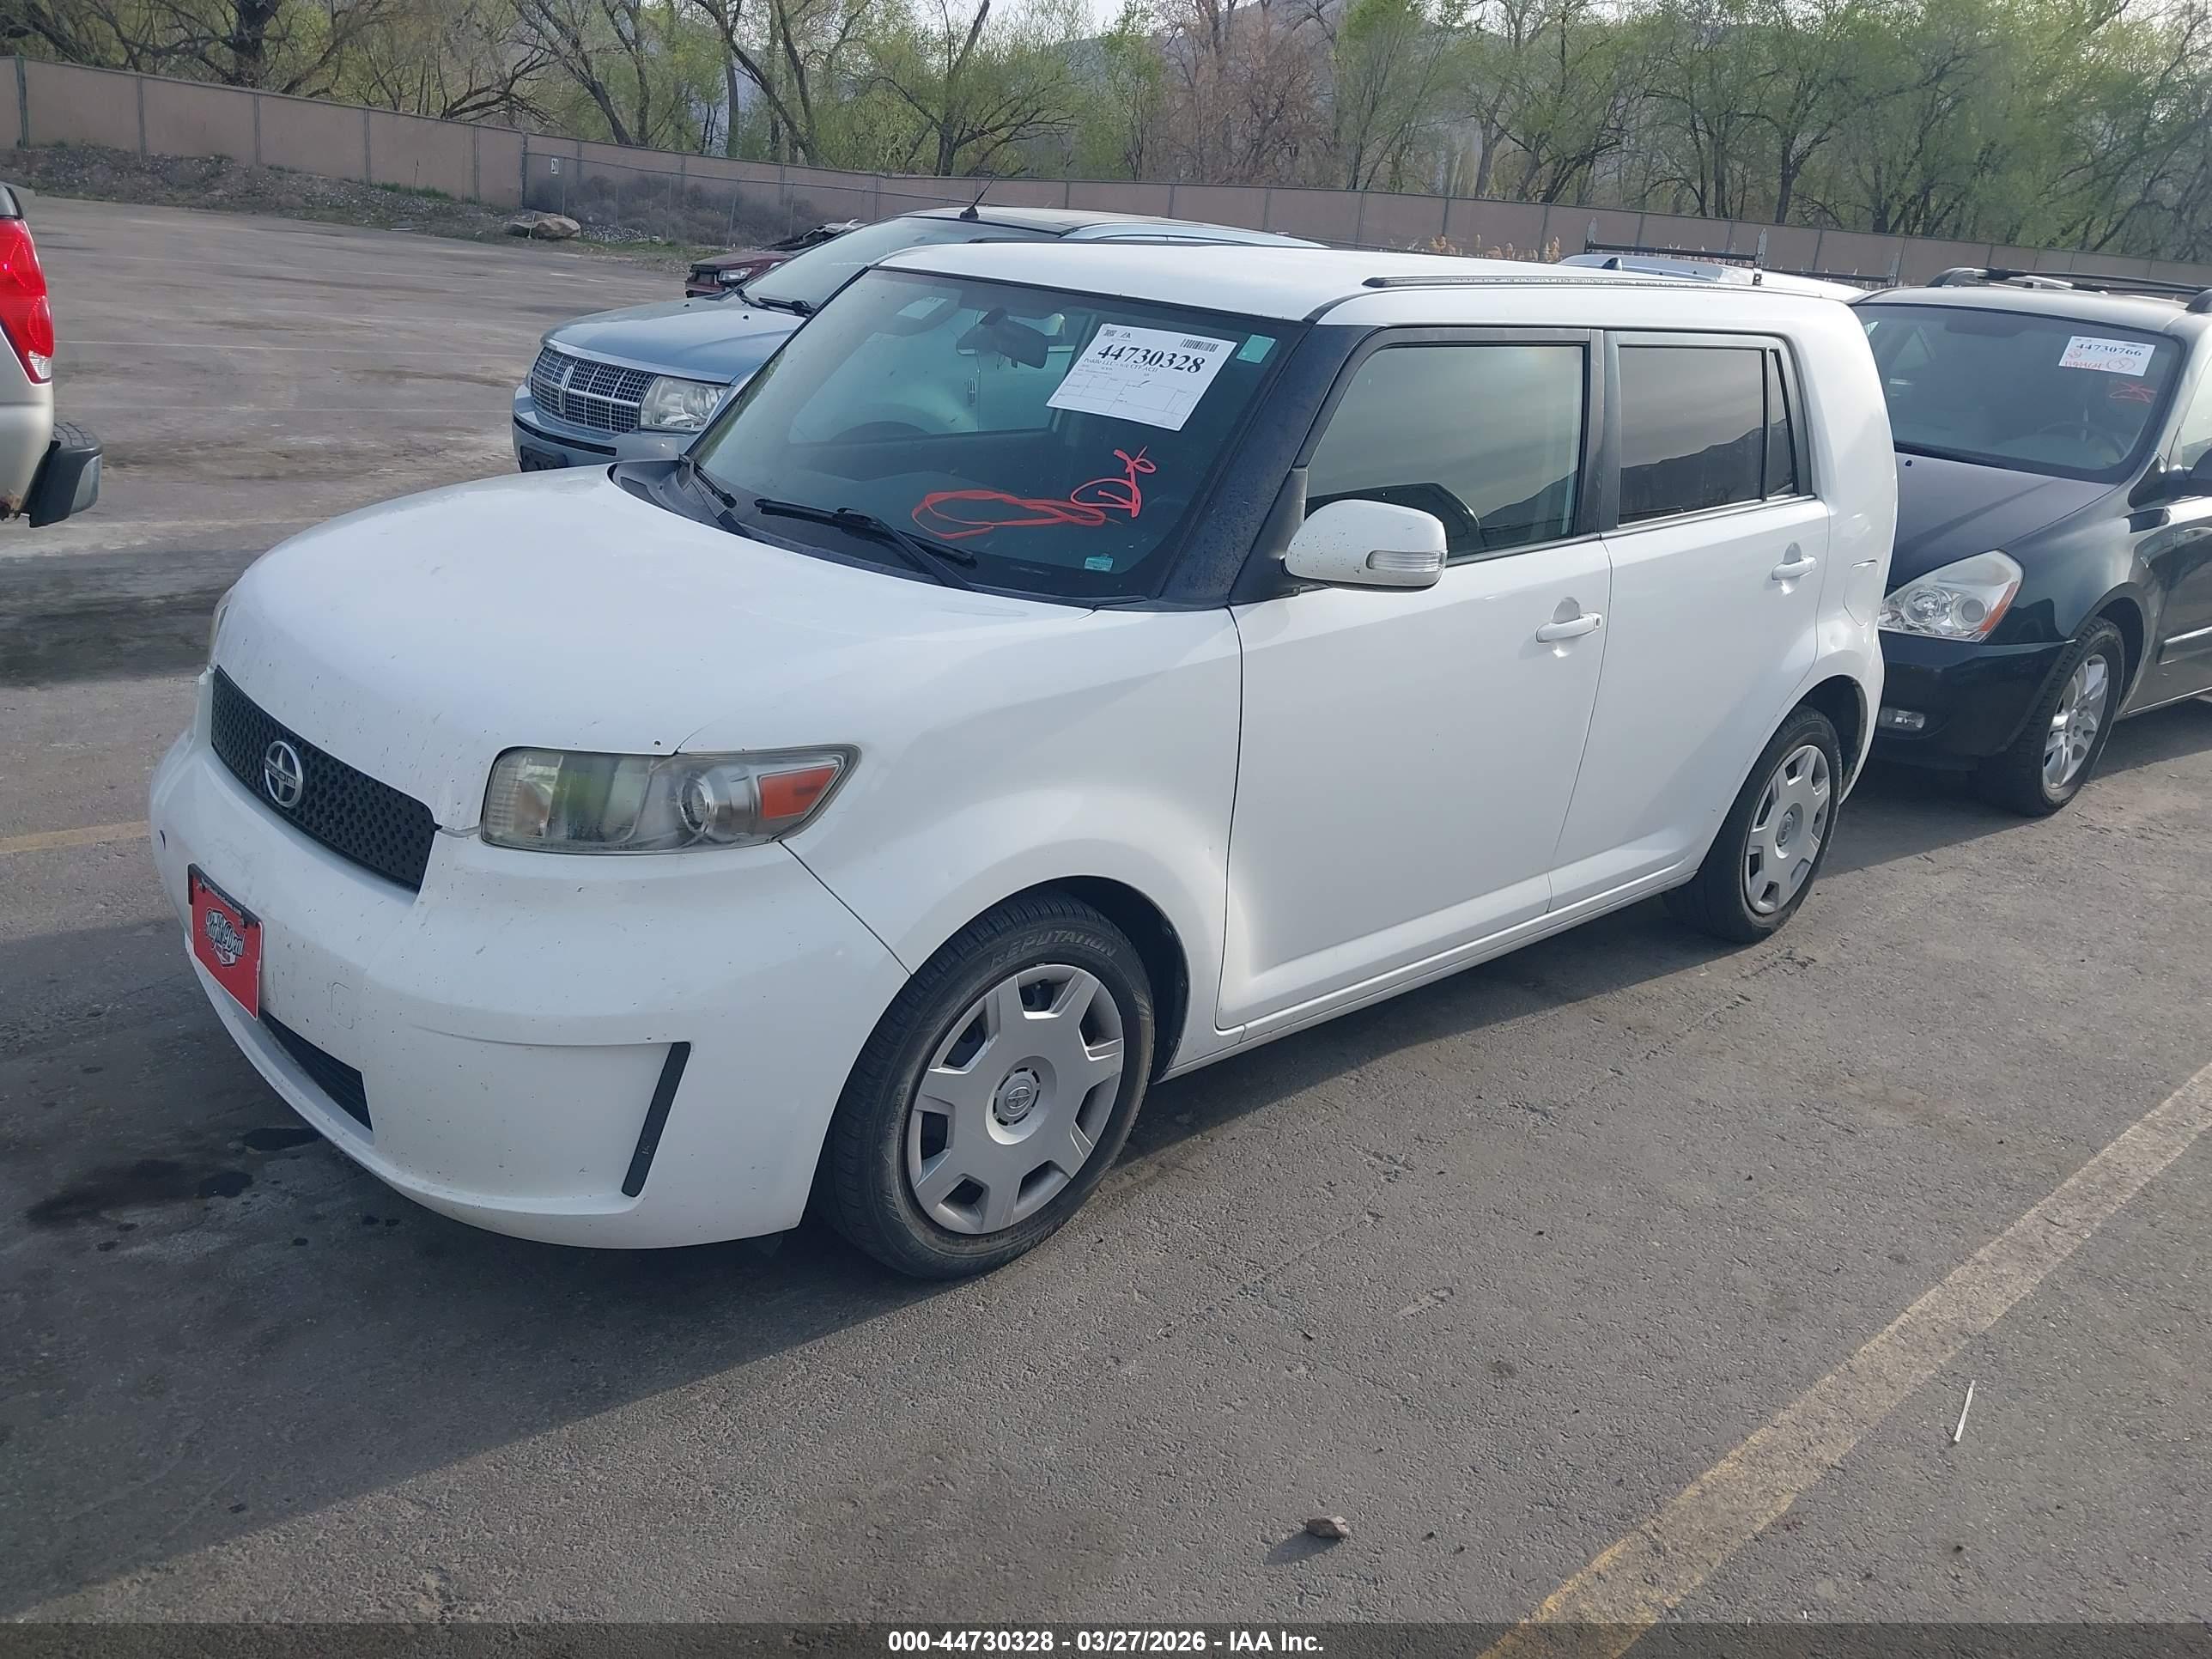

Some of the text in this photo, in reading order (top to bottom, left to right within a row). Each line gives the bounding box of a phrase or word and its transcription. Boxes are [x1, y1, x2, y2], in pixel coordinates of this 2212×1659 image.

[1097, 343, 1206, 374] 44730328
[2076, 343, 2142, 356] 44730766
[990, 929, 1117, 968] REPUTATION
